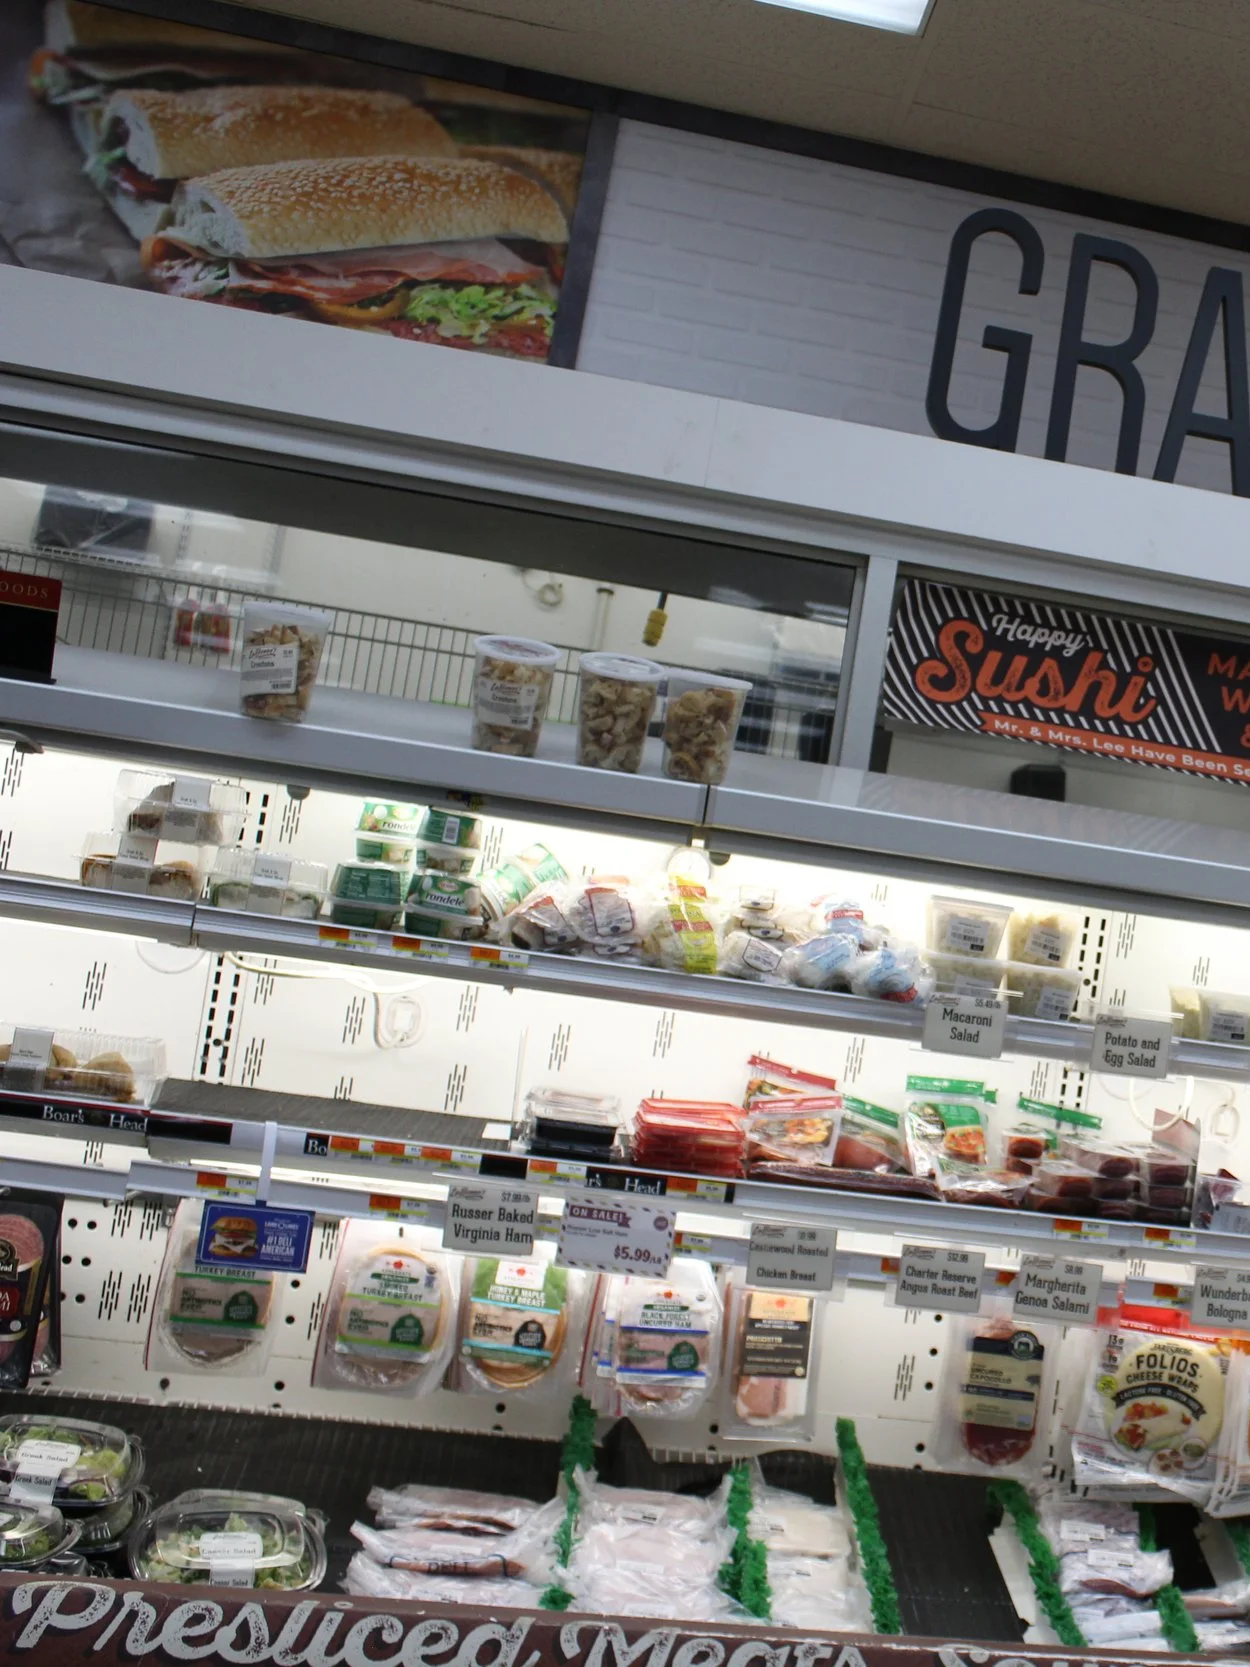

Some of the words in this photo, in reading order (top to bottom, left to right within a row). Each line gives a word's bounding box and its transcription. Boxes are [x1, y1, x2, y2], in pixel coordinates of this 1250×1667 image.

[992, 614, 1088, 657] Happy
[915, 619, 1157, 723] Sushi
[994, 719, 1023, 734] Mr.
[1030, 726, 1042, 738] &
[1049, 730, 1088, 747] Mrs.
[1093, 738, 1125, 753] Lee
[1131, 745, 1176, 764] Have
[1182, 755, 1228, 773] Been
[941, 1007, 993, 1028] Macaroni
[949, 1027, 980, 1044] Salad
[1104, 1031, 1138, 1049] Potato
[1141, 1037, 1161, 1051] and
[1104, 1051, 1124, 1068] Egg
[1127, 1052, 1157, 1068] Salad
[42, 1104, 85, 1123] Boar's
[109, 1113, 148, 1132] Head
[308, 1138, 327, 1155] Bo
[624, 1177, 662, 1196] Head
[451, 1203, 494, 1221] Russer
[497, 1207, 534, 1224] Baked
[572, 1207, 588, 1217] ON
[592, 1210, 623, 1222] SALE!
[454, 1223, 500, 1244] Virginia
[504, 1227, 533, 1244] Ham
[756, 1266, 788, 1279] Chicken
[790, 1269, 817, 1282] Breast
[905, 1265, 938, 1280] Charter
[941, 1269, 977, 1284] Reserve
[1024, 1273, 1086, 1296] Margherita
[900, 1282, 928, 1296] Angus
[931, 1283, 957, 1297] Roast
[959, 1287, 979, 1300] Beef
[1015, 1291, 1048, 1309] Genoa
[1051, 1296, 1090, 1315] Salami
[1206, 1303, 1248, 1323] Bologna
[1135, 1353, 1200, 1378] FOLIOS
[1125, 1370, 1164, 1383] CHEESE
[1168, 1372, 1200, 1394] WRAPS
[12, 1580, 542, 1667] Presliced
